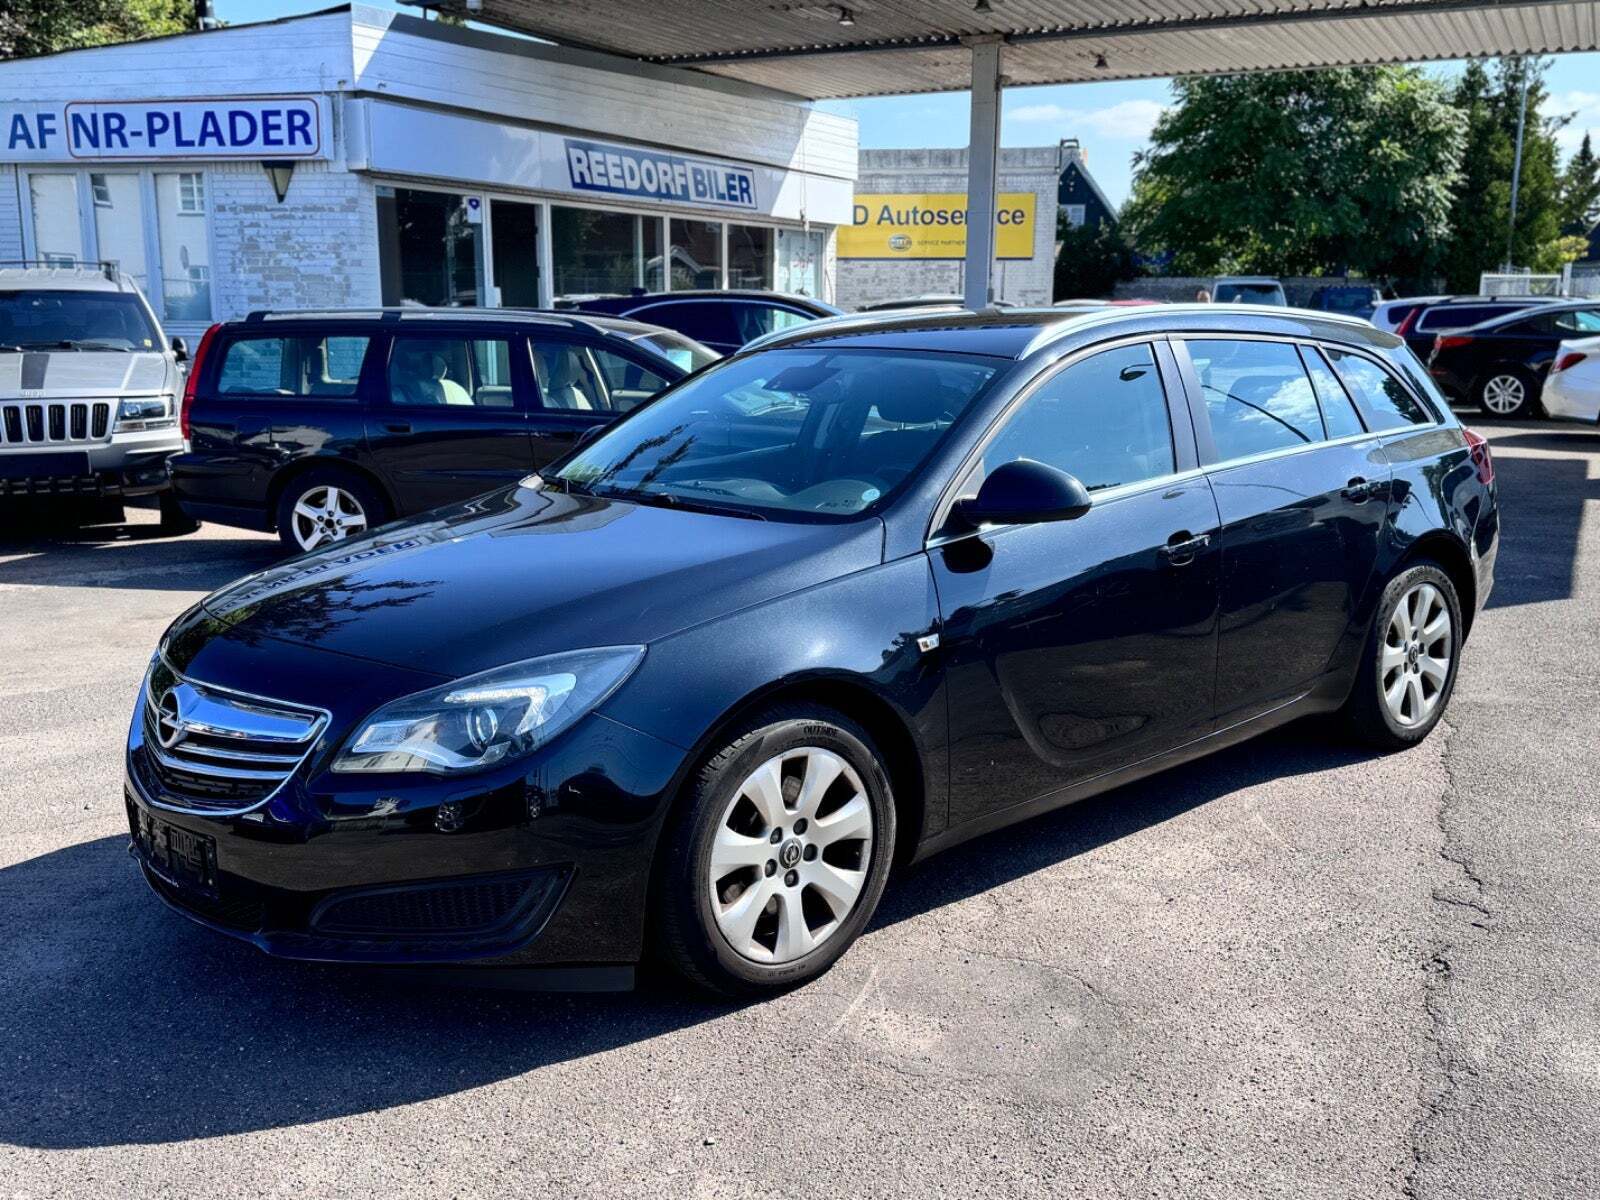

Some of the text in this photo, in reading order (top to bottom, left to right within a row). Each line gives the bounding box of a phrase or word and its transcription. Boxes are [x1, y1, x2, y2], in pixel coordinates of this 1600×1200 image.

[8, 108, 313, 150] AF NR-PLADER
[568, 147, 752, 205] REEDORF BILER
